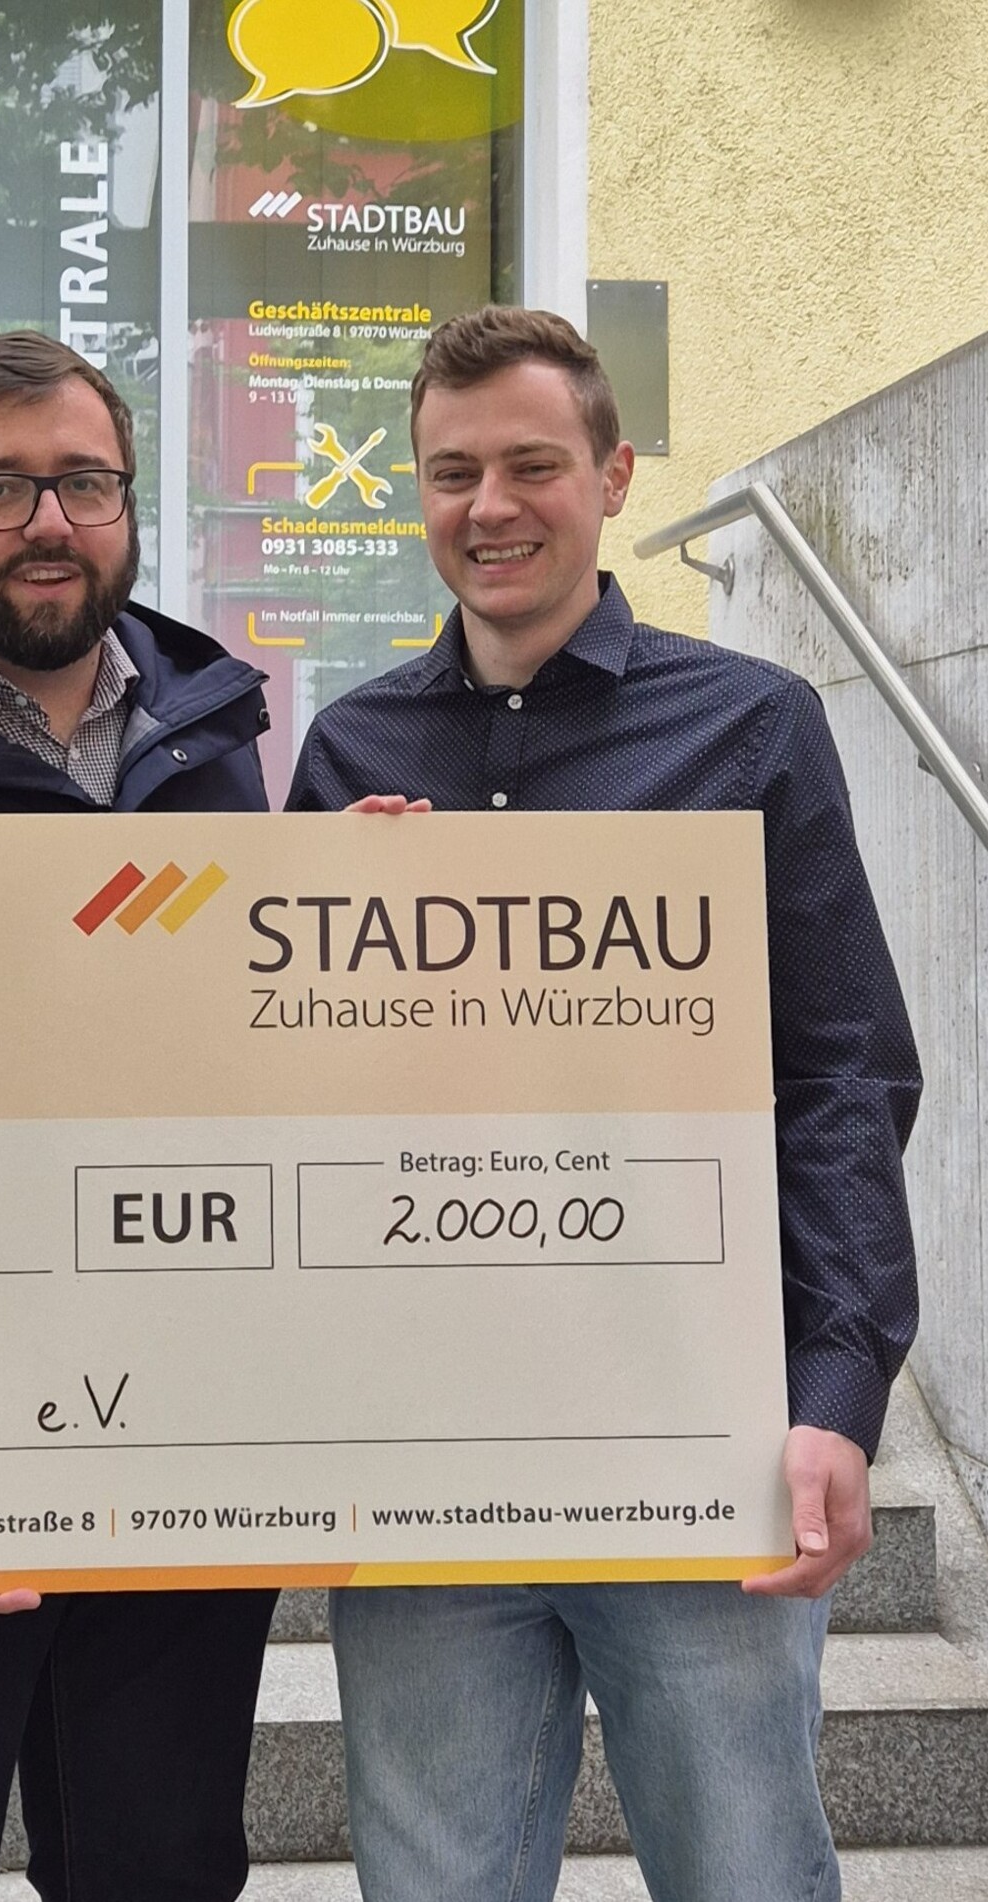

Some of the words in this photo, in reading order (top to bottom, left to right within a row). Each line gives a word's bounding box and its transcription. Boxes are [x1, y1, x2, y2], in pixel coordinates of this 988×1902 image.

[307, 204, 465, 235] STADTBAU
[60, 141, 108, 369] TRALE
[307, 235, 370, 251] Zuhause
[375, 236, 388, 251] in
[392, 237, 465, 257] Würzburg
[249, 301, 432, 322] Geschäftszentrale
[248, 323, 331, 339] Ludwigstraße
[333, 325, 341, 337] 8
[349, 326, 387, 338] 97070
[249, 353, 352, 369] Öffnungszeiten:
[304, 374, 359, 391] Dienstag
[362, 376, 372, 389] &
[249, 391, 257, 403] 9
[271, 391, 285, 403] 13
[262, 538, 306, 555] 0931
[312, 539, 399, 556] 3085-333
[263, 563, 280, 575] Mo
[320, 565, 331, 576] 12
[332, 565, 351, 576] Uhr
[262, 610, 277, 622] Im
[280, 610, 320, 622] Notfall
[322, 610, 361, 623] immer
[364, 611, 427, 624] erreichbar.
[249, 896, 711, 973] STADTBAU
[250, 988, 434, 1028] Zuhause
[451, 989, 485, 1026] in
[501, 986, 714, 1036] Würzburg
[401, 1152, 483, 1177] Betrag:
[491, 1151, 548, 1174] Euro,
[555, 1150, 610, 1171] Cent
[114, 1192, 237, 1244] EUR
[383, 1195, 624, 1248] 2.000,00
[38, 1373, 129, 1432] e.V.
[81, 1512, 95, 1531] 8
[131, 1509, 207, 1530] 97070
[214, 1506, 336, 1532] Würzburg
[372, 1499, 735, 1526] www.stadtbau-wuerzburg.de
